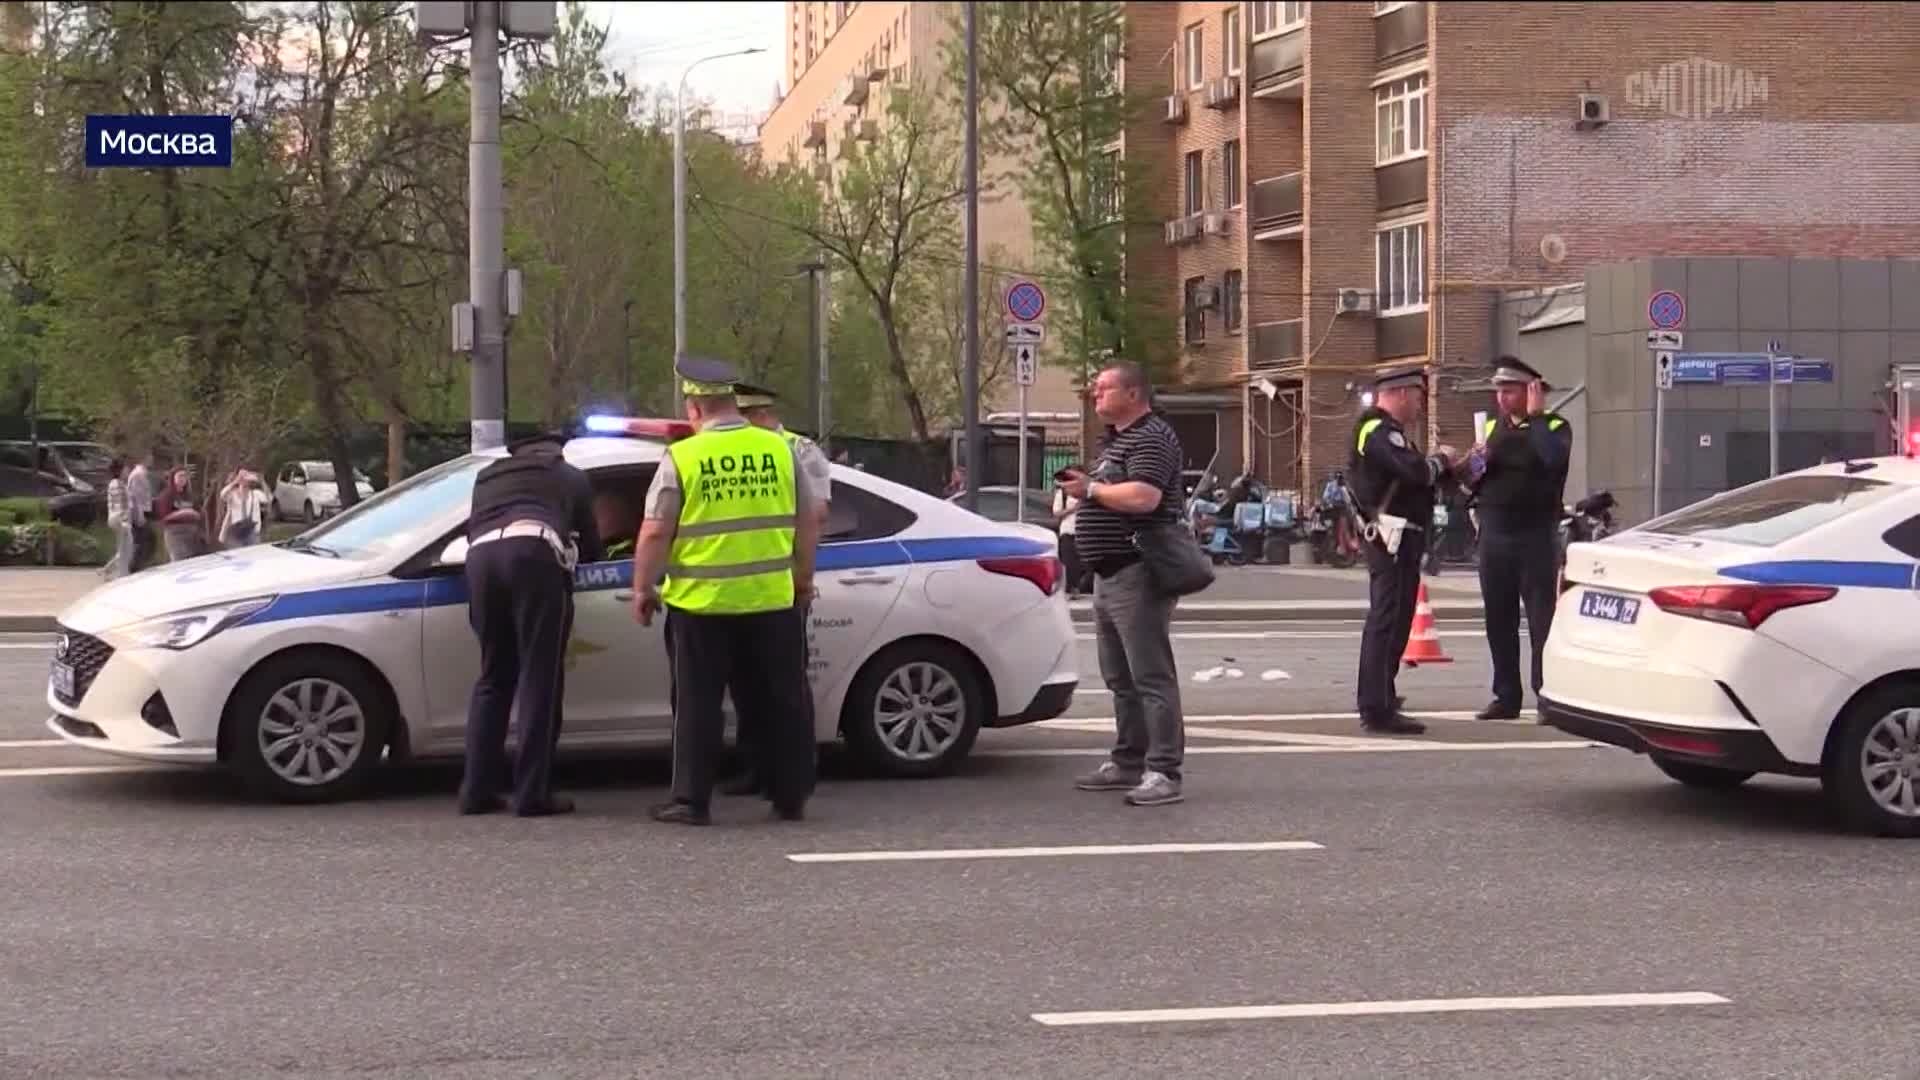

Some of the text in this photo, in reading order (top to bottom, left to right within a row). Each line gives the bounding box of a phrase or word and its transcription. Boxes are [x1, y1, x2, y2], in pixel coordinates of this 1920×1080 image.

[700, 453, 777, 476] ЦОДД
[702, 474, 778, 491] ДОРОЖНЫЙ
[702, 487, 778, 503] ПАТРУЛЬ
